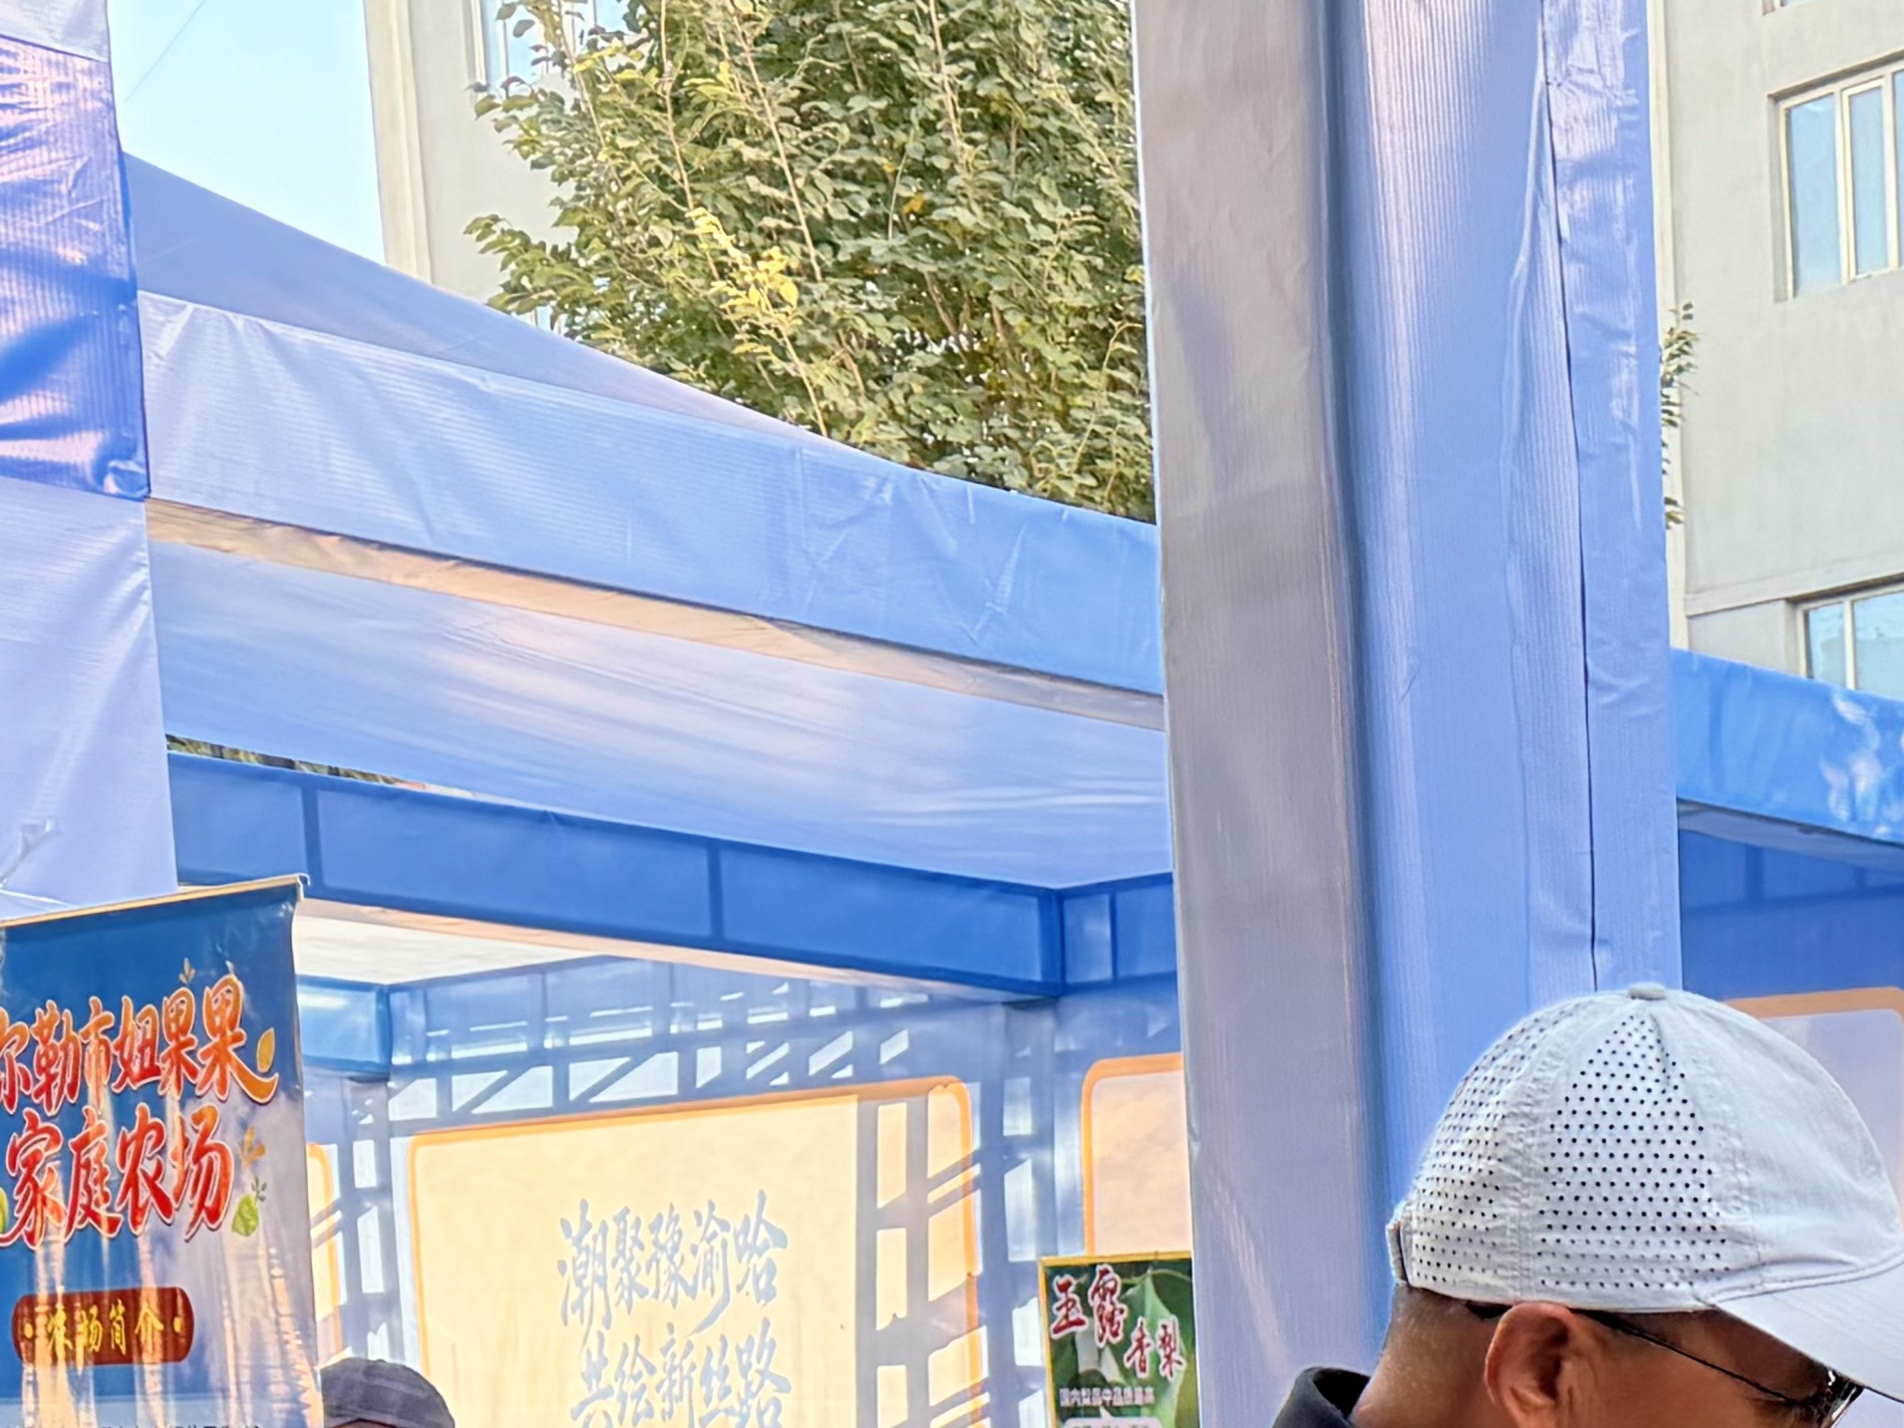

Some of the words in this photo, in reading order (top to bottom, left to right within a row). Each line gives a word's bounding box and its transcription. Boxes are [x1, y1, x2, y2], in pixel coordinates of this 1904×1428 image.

[0, 1105, 236, 1247] 家庭农场
[557, 1189, 788, 1348] 潮聚豫渝哈
